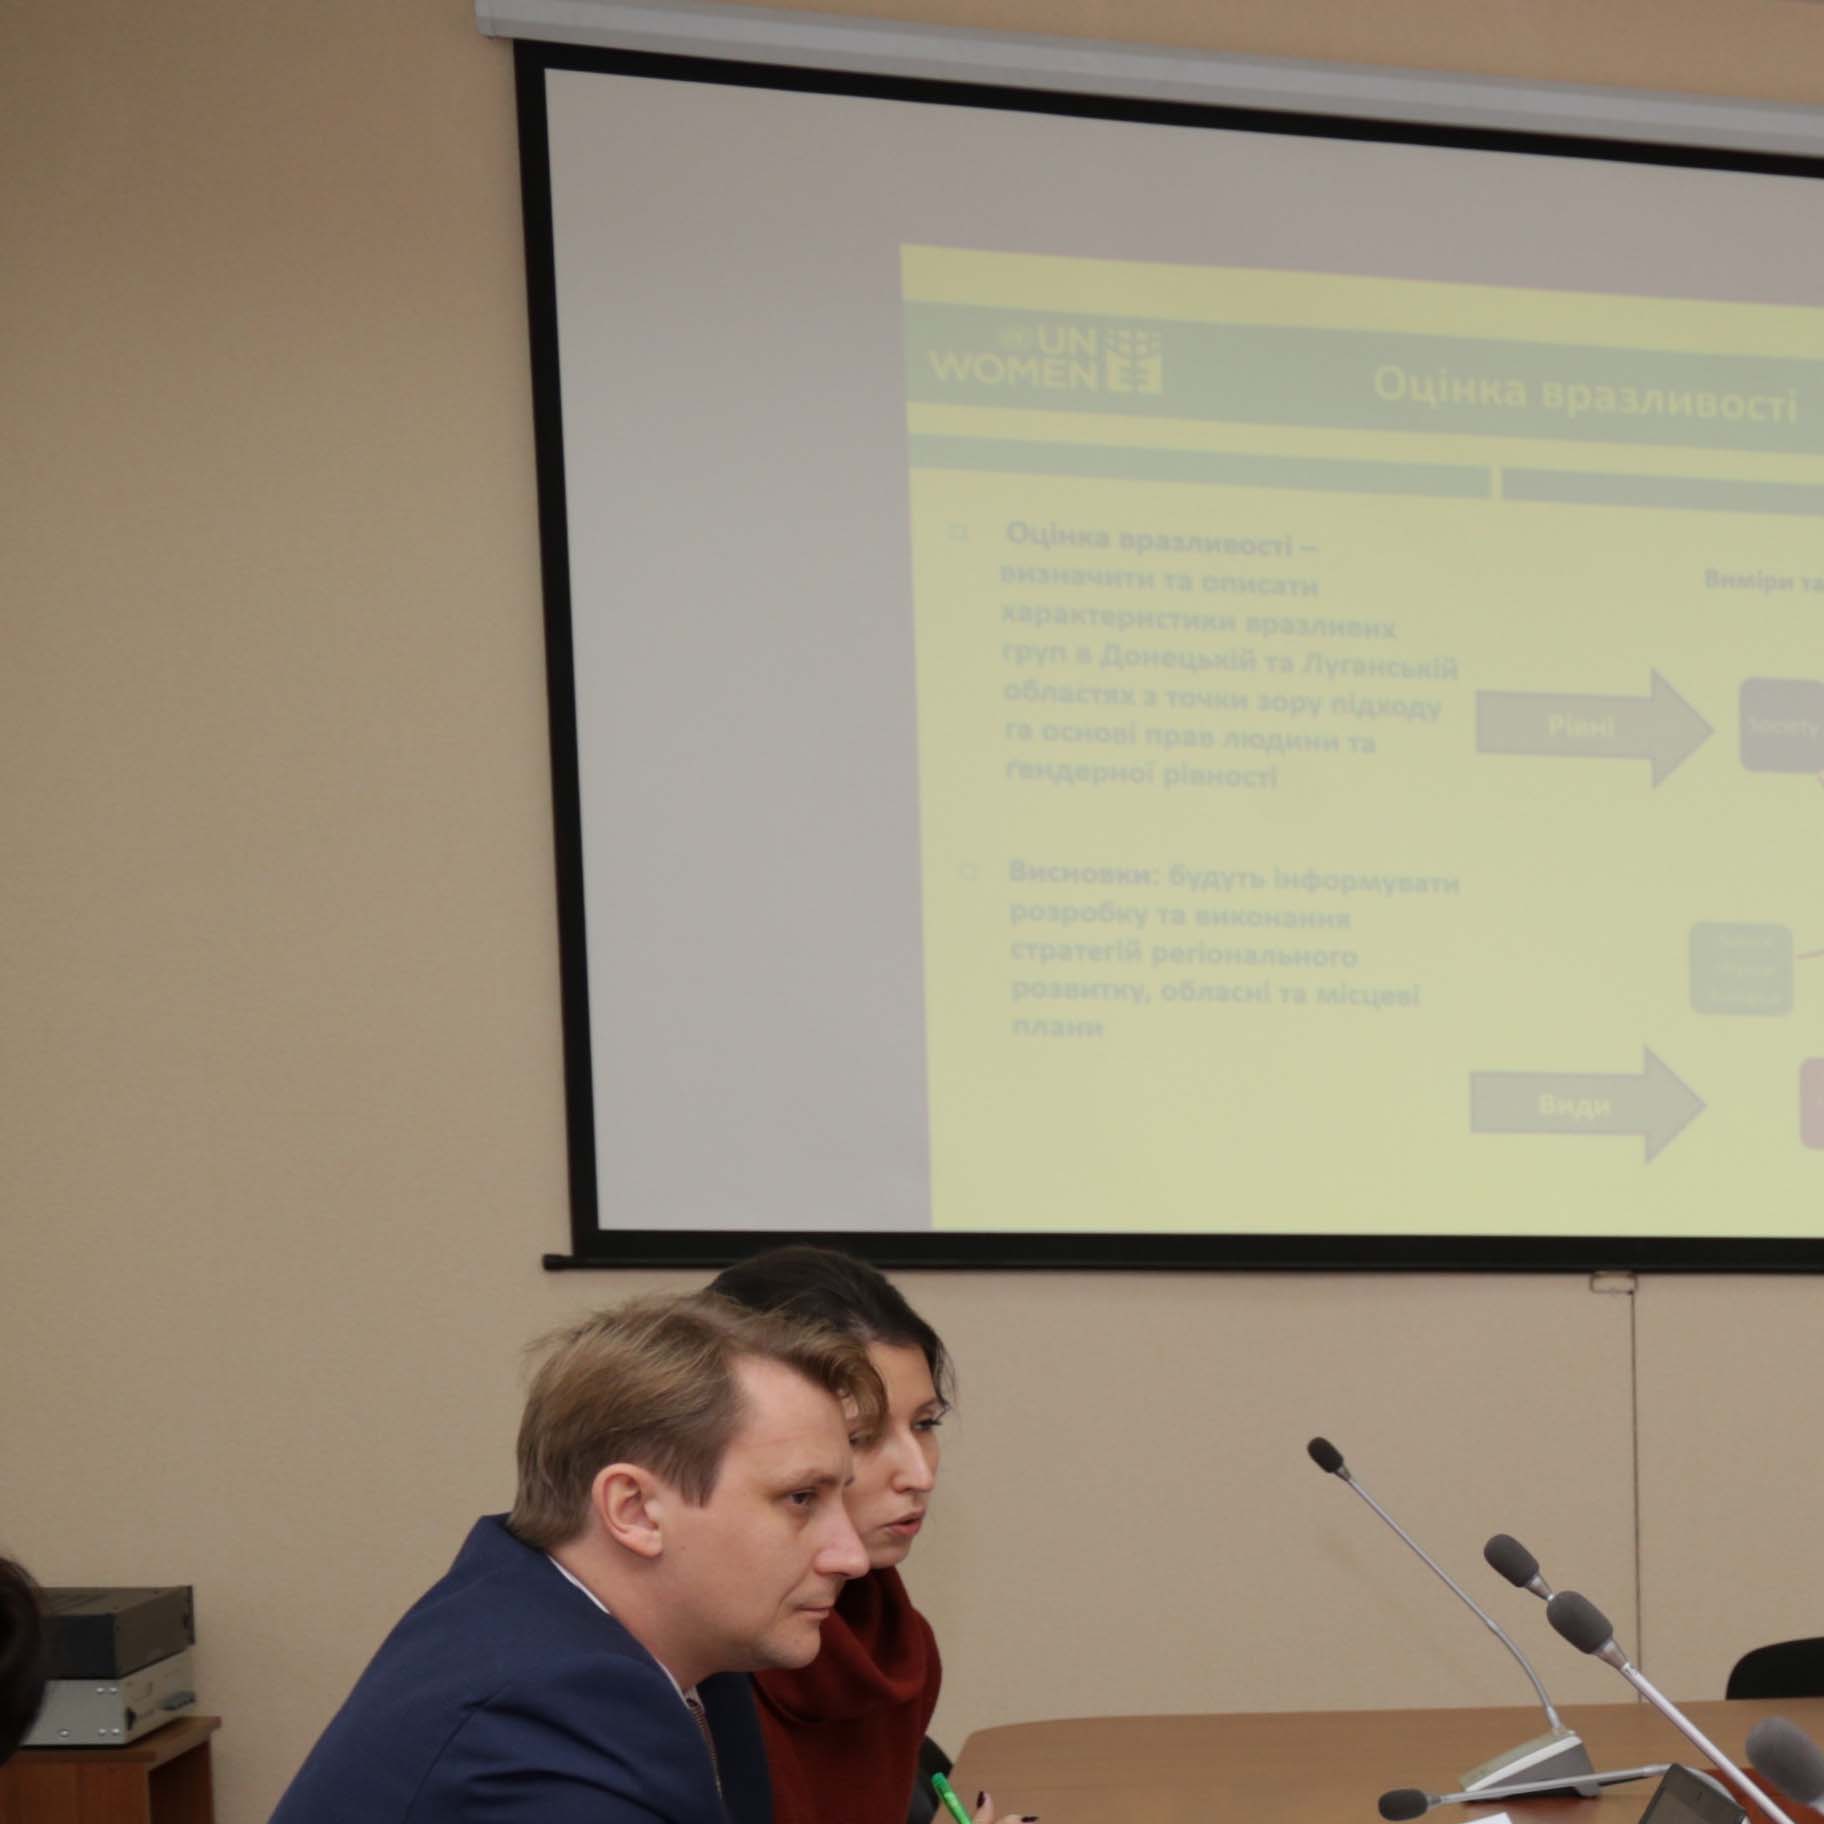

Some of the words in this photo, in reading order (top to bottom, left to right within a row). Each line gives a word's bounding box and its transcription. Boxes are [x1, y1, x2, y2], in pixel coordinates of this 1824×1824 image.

[1037, 327, 1096, 357] UN
[930, 350, 1098, 391] WOMEN
[1373, 364, 1527, 409] Оцінка
[1541, 374, 1799, 425] вразливості
[1005, 520, 1110, 550] Оцінка
[1119, 530, 1294, 558] вразливості
[1000, 563, 1154, 590] визначити
[1164, 572, 1193, 592] та
[1265, 654, 1294, 674] та
[1348, 735, 1377, 755] та
[1157, 905, 1186, 926] та
[1279, 984, 1307, 1005] та
[1011, 1016, 1105, 1039] плани
[1537, 1091, 1613, 1122] Види
